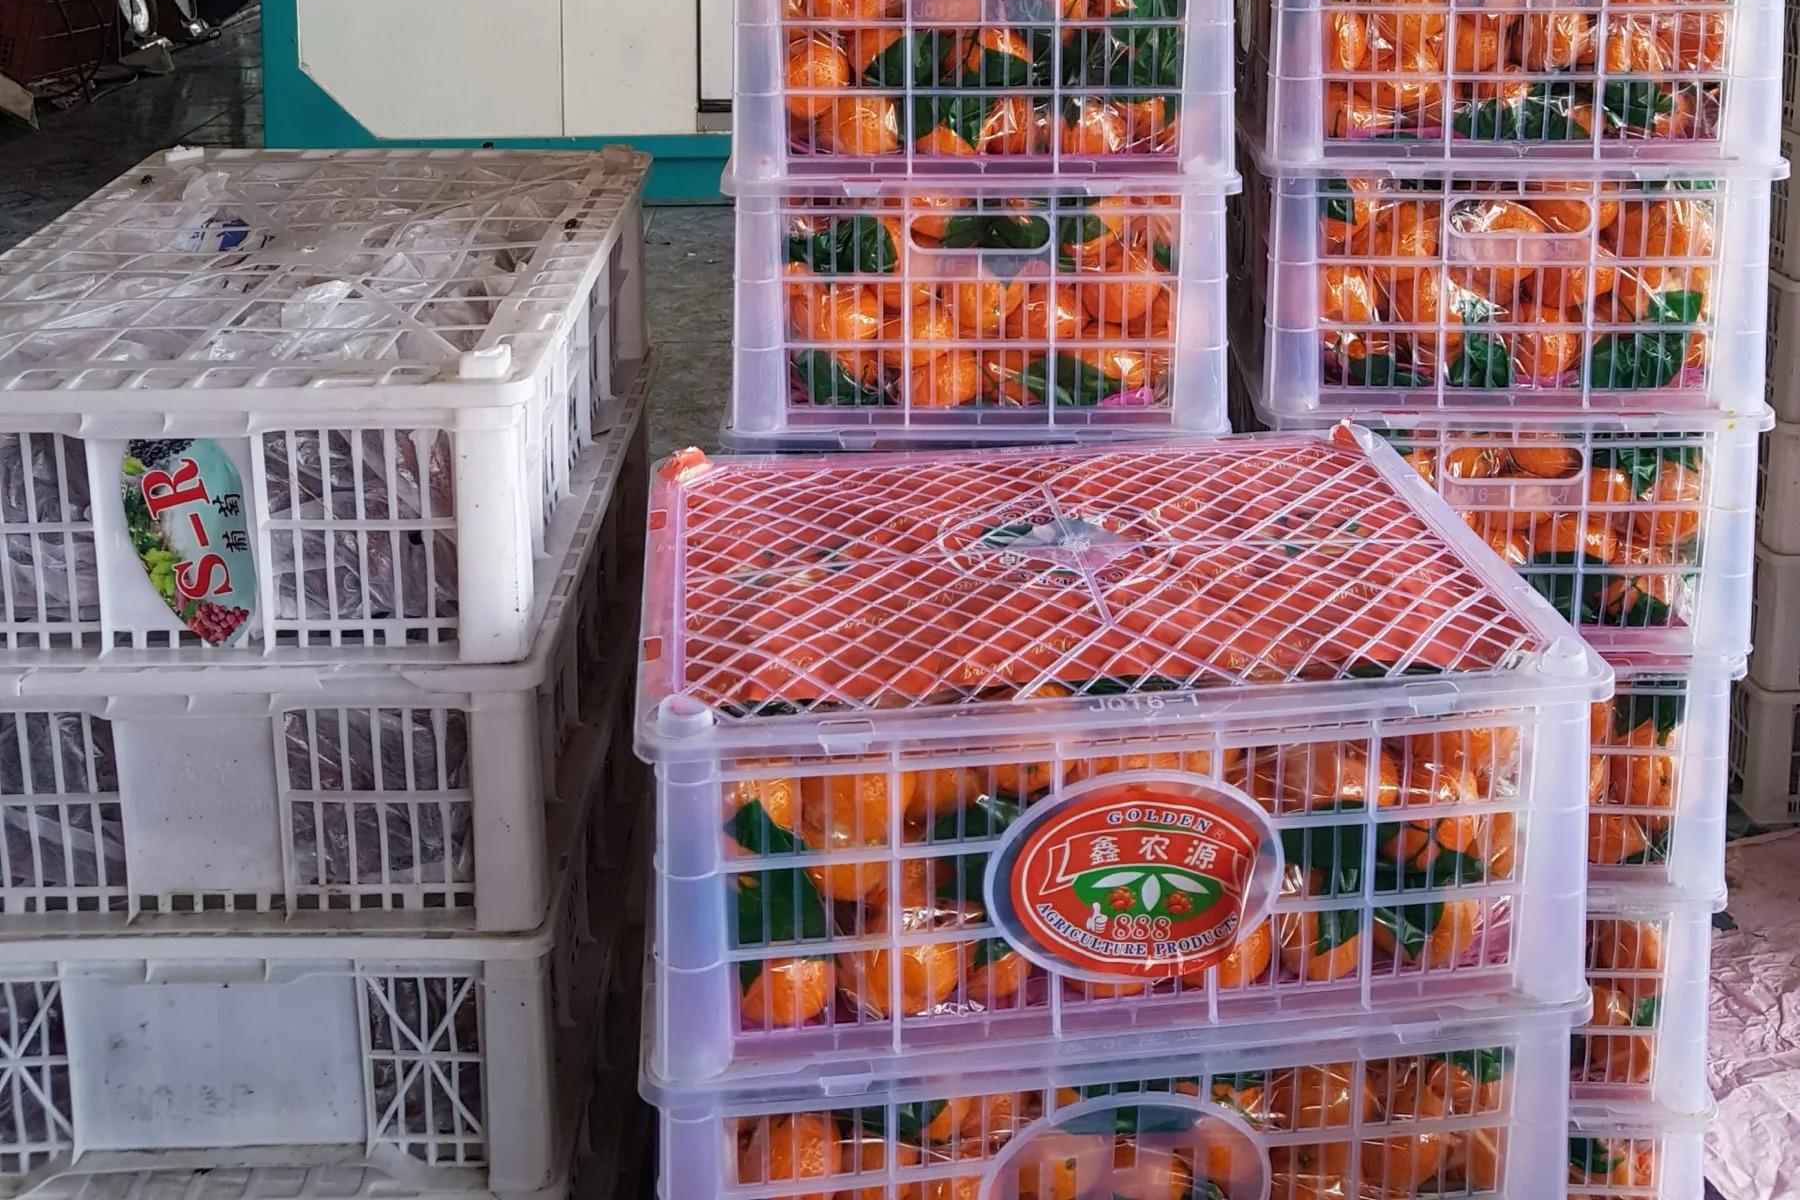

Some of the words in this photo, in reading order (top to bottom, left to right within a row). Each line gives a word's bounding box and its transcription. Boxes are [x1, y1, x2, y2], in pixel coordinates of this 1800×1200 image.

[141, 457, 233, 600] S-R
[212, 491, 248, 554] 葡萄
[1107, 808, 1213, 834] GOLDEN
[1089, 834, 1219, 869] 鑫农源
[1037, 902, 1148, 957] AGRICULTURE
[1153, 911, 1239, 957] PRODUCTS
[1112, 913, 1172, 942] 888
